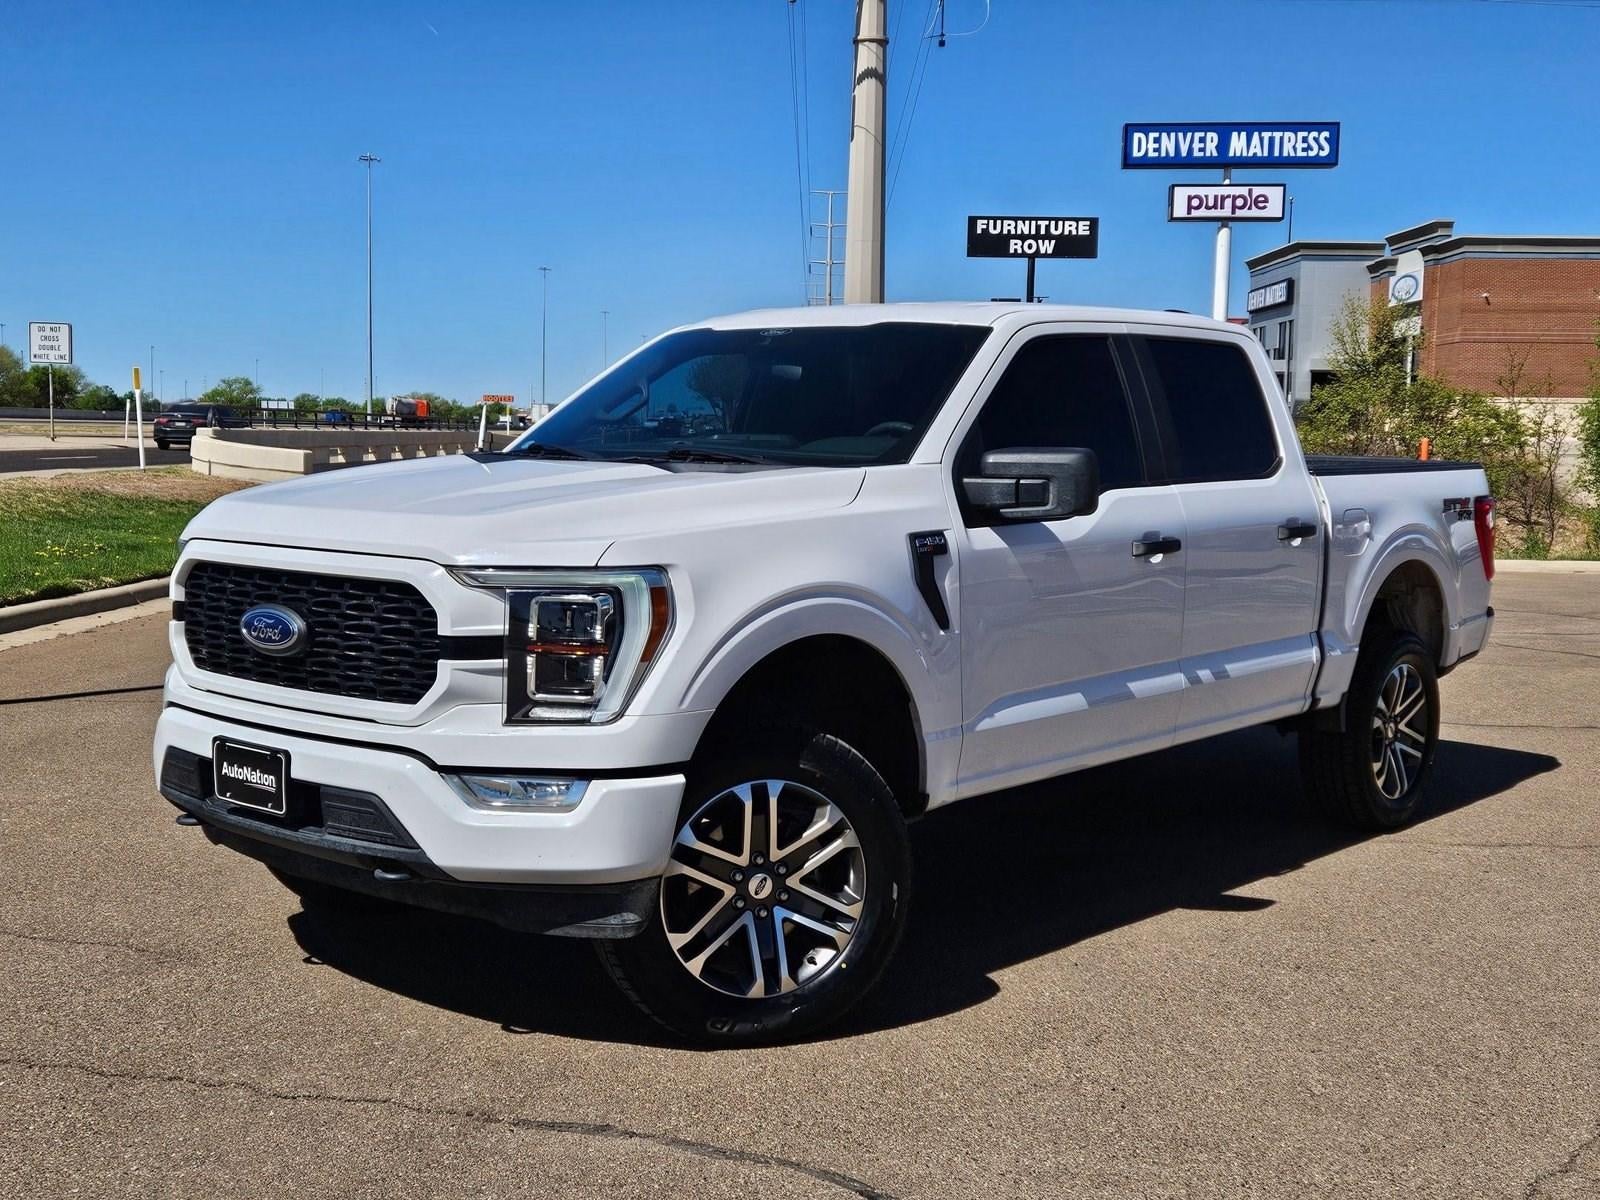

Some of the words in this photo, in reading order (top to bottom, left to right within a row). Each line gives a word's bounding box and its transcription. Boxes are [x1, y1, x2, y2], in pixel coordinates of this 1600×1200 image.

[1132, 131, 1219, 158] DENVER
[1228, 130, 1331, 158] MATTRESS
[1186, 187, 1270, 216] purple
[976, 219, 1091, 236] FURNITURE
[1009, 238, 1056, 255] ROW
[32, 353, 50, 361] WHITE
[54, 353, 68, 361] LINE
[250, 616, 282, 641] Ford
[221, 761, 277, 789] AutoNation
